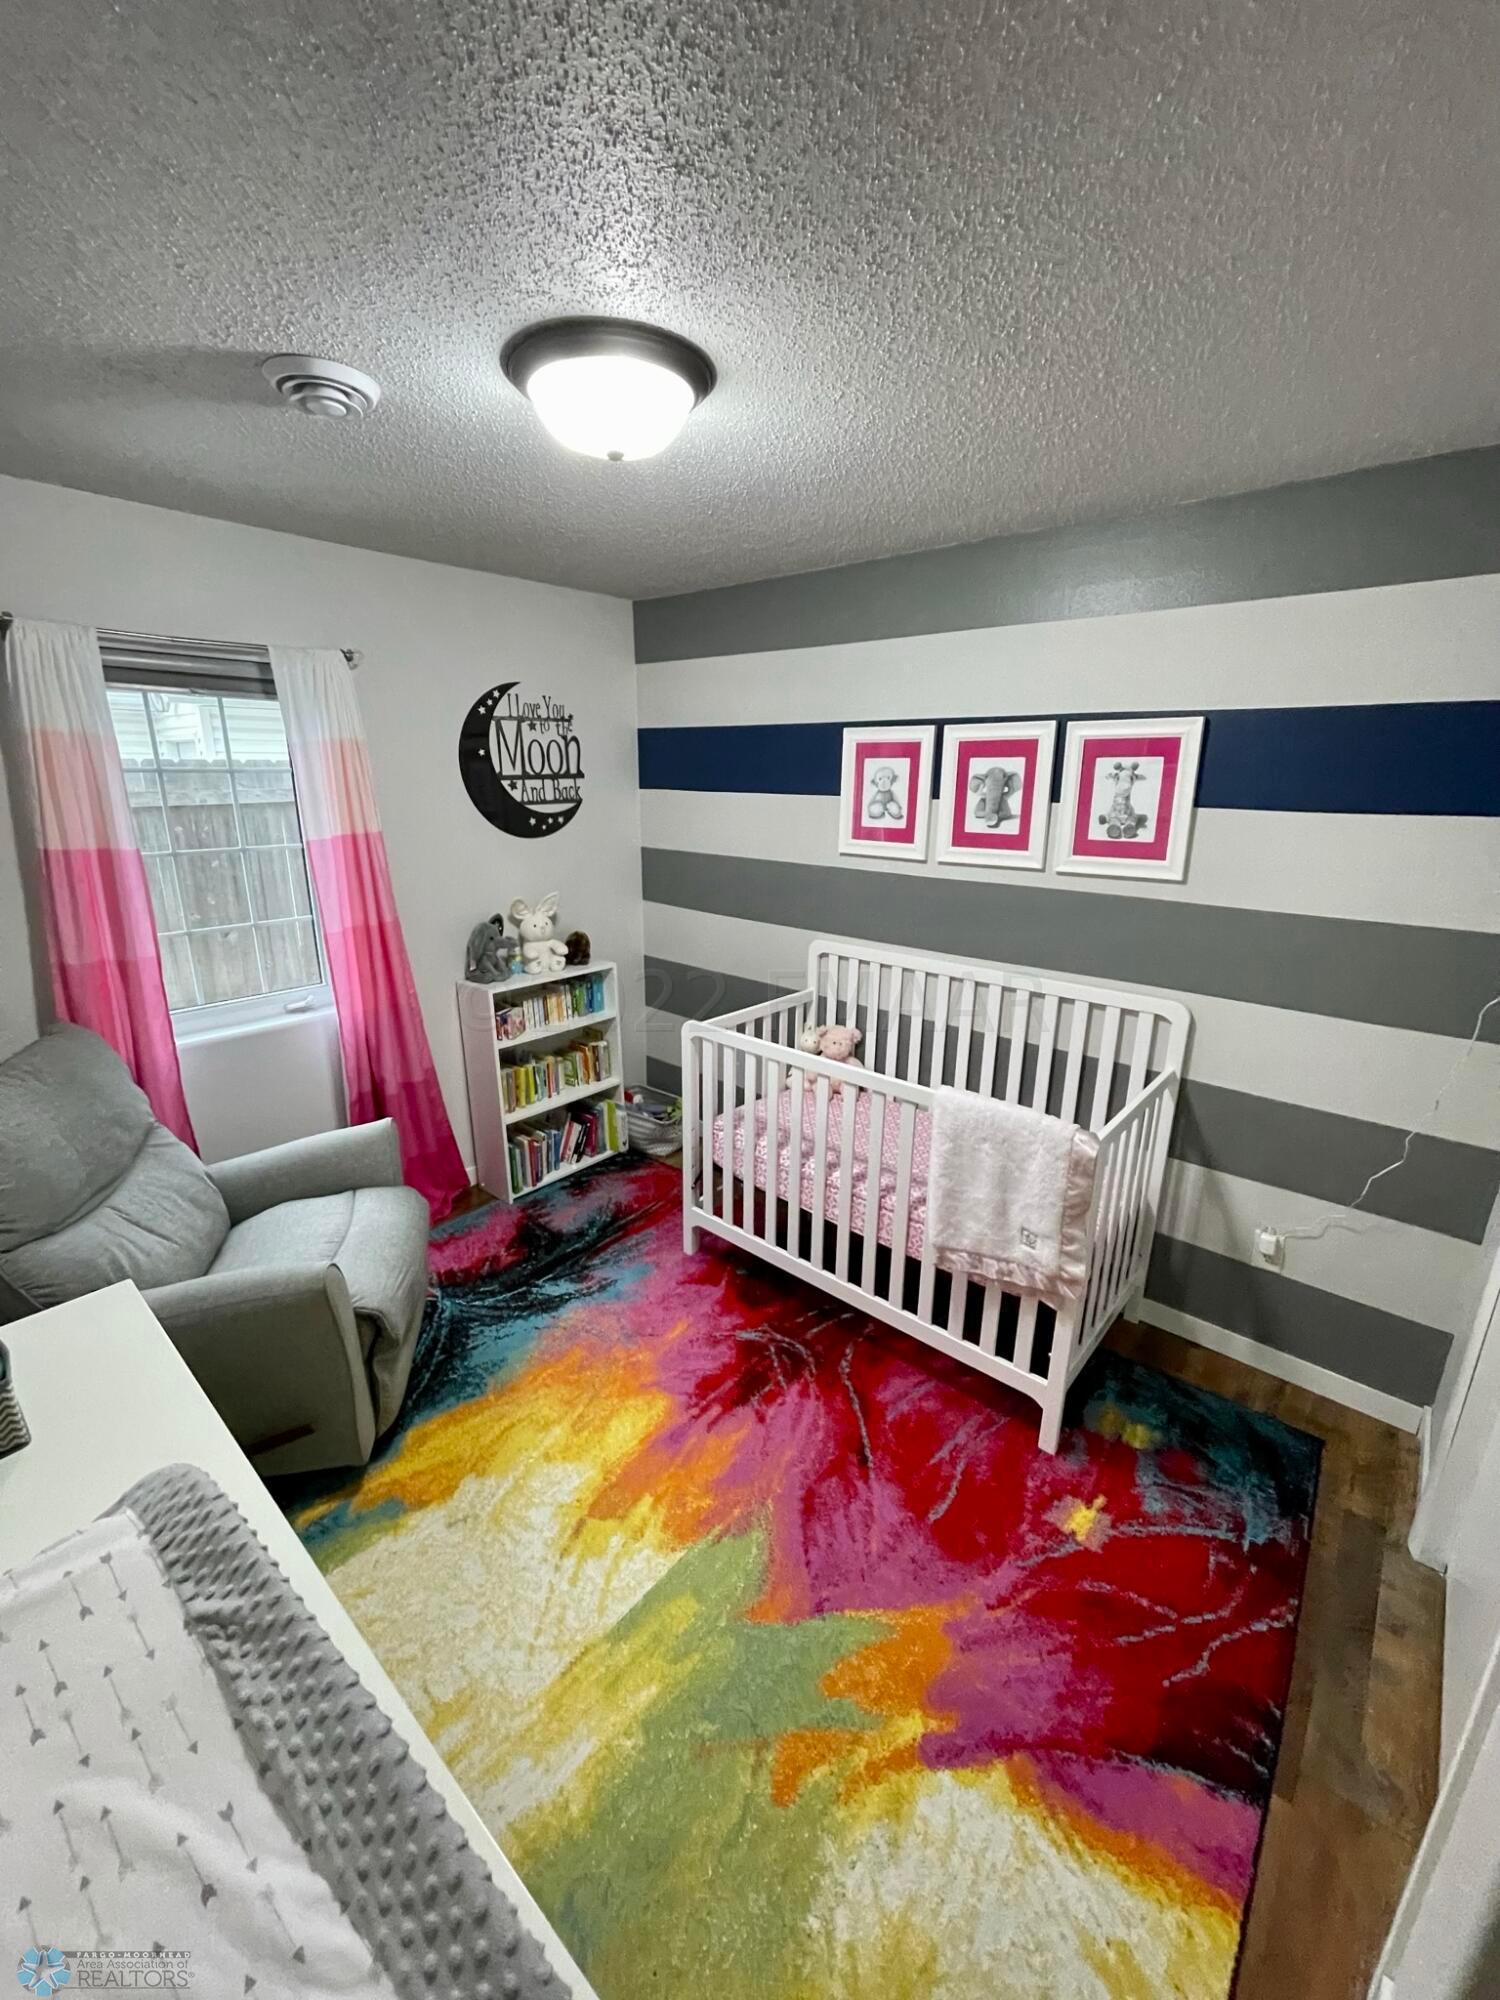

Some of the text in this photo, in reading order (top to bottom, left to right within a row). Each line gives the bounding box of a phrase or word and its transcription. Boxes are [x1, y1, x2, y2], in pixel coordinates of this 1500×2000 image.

[507, 693, 565, 719] I Love You
[540, 718, 573, 736] to the
[494, 719, 583, 777] Moon
[521, 778, 581, 801] And Back
